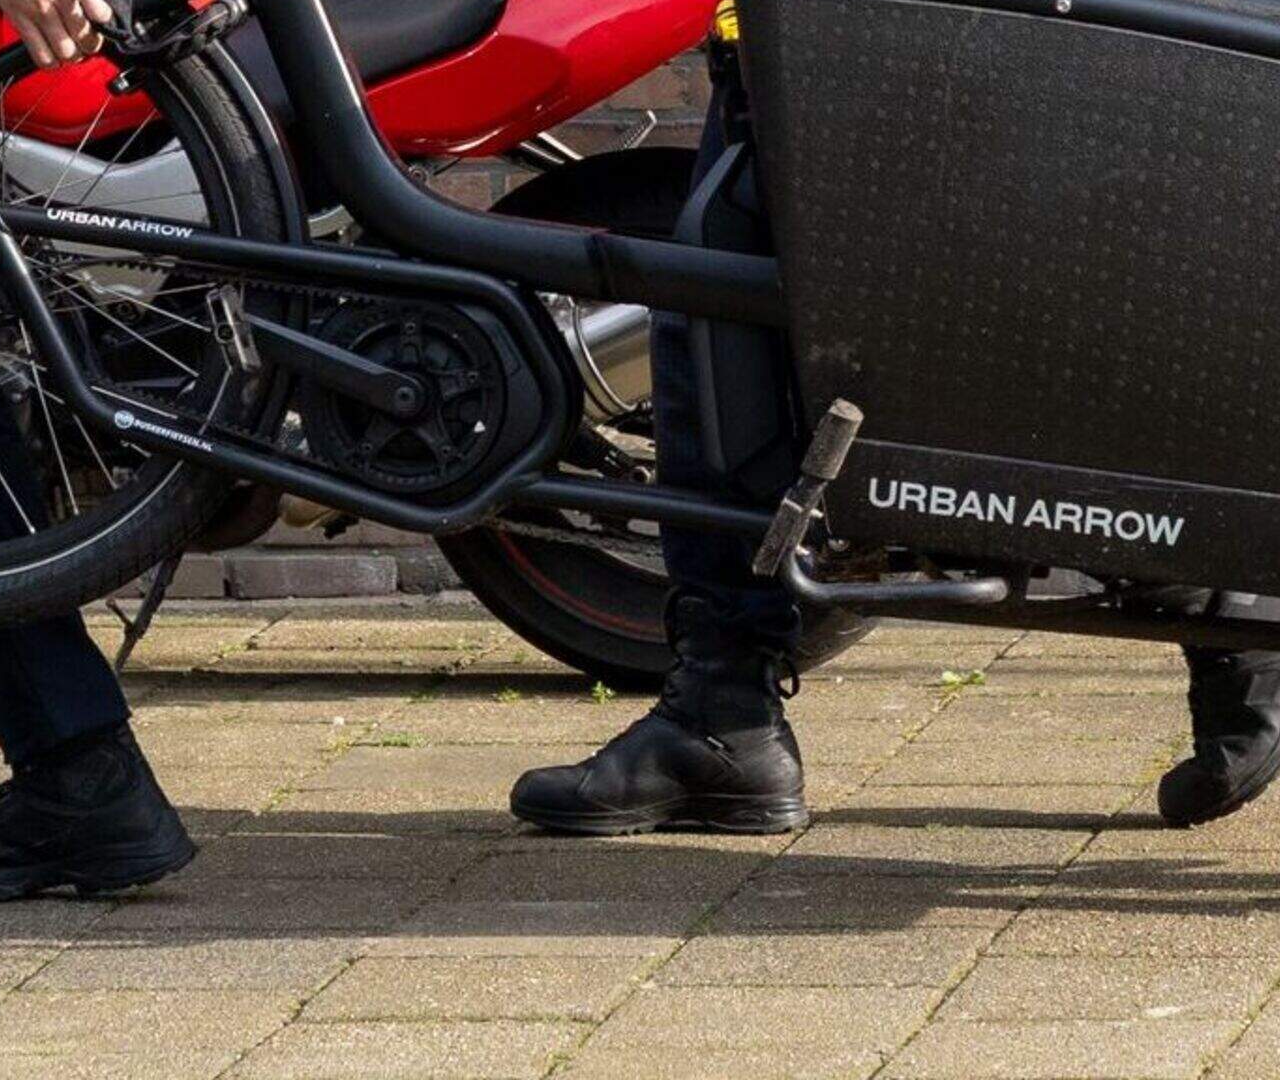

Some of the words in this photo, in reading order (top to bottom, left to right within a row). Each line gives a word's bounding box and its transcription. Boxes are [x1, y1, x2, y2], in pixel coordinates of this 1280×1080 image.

[47, 208, 115, 228] URBAN
[119, 219, 193, 238] ARROW
[869, 478, 1016, 524] URBAN
[1023, 500, 1184, 546] ARROW
